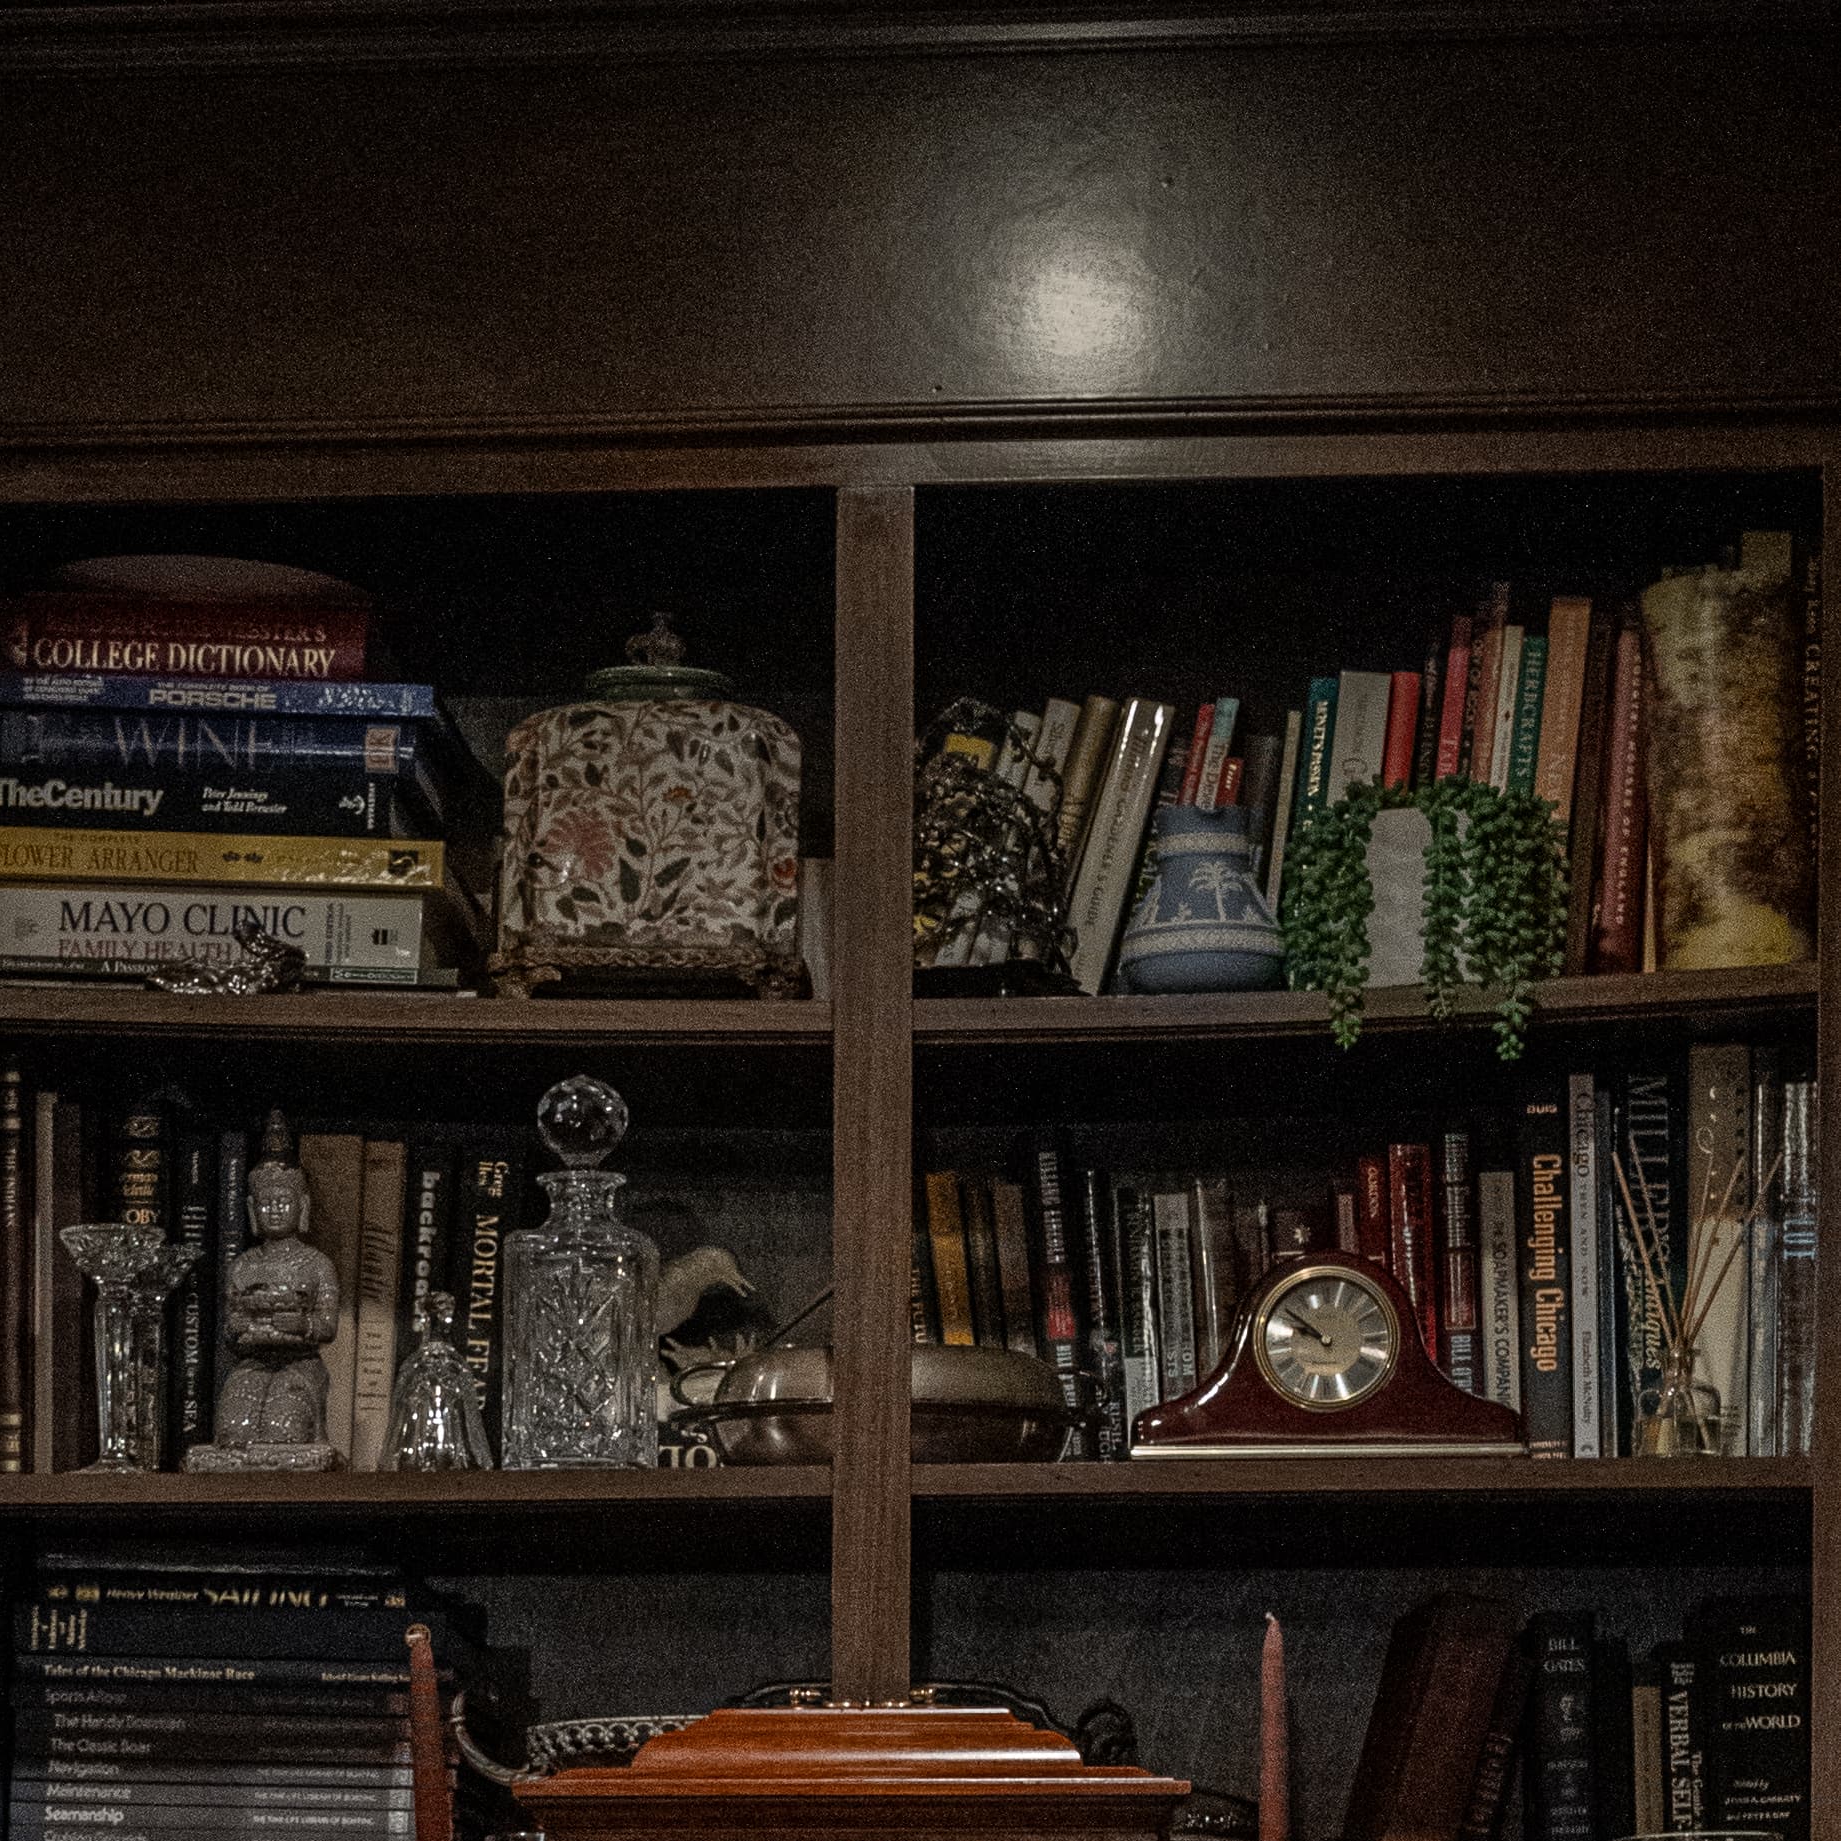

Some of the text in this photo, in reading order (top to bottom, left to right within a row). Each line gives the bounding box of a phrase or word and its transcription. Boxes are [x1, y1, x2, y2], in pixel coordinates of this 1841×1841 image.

[32, 637, 336, 678] COLLEGE DICTIONARY
[149, 688, 277, 709] PORSCHE
[1514, 651, 1541, 778] HERBCRAFTS
[89, 845, 199, 874] ARRANGER
[59, 901, 171, 935] MAYO
[183, 902, 307, 937] CLINIC
[1084, 887, 1102, 928] GUIDE
[59, 938, 135, 959] FAMILY
[143, 940, 231, 962] HEALTH
[1572, 1092, 1594, 1179] Chicago
[477, 1161, 491, 1188] Iles
[489, 1161, 510, 1198] Greg
[1624, 1073, 1671, 1264] MILLER'S
[466, 1214, 498, 1331] MORTAL
[1525, 1153, 1563, 1372] Challenging Chicago
[1491, 1240, 1510, 1336] SOAPMAKER'S
[182, 1292, 198, 1432] CUSTOM SEA
[1578, 1331, 1594, 1425] Elizabeth McNulty
[106, 1587, 146, 1601] Heavy
[1548, 1637, 1580, 1652] BILL
[44, 1664, 255, 1682] Tales of the Chicago Race
[1543, 1659, 1587, 1673] GATES
[1719, 1651, 1797, 1668] COLUMBIA
[1731, 1682, 1798, 1700] HISTORY
[54, 1713, 79, 1728] The
[1668, 1690, 1690, 1774] VERBAL
[1745, 1715, 1801, 1731] WORLD
[51, 1737, 75, 1752] The
[48, 1760, 120, 1777] Navigation
[45, 1784, 132, 1800] Maintenance
[43, 1805, 125, 1825] Seamanship
